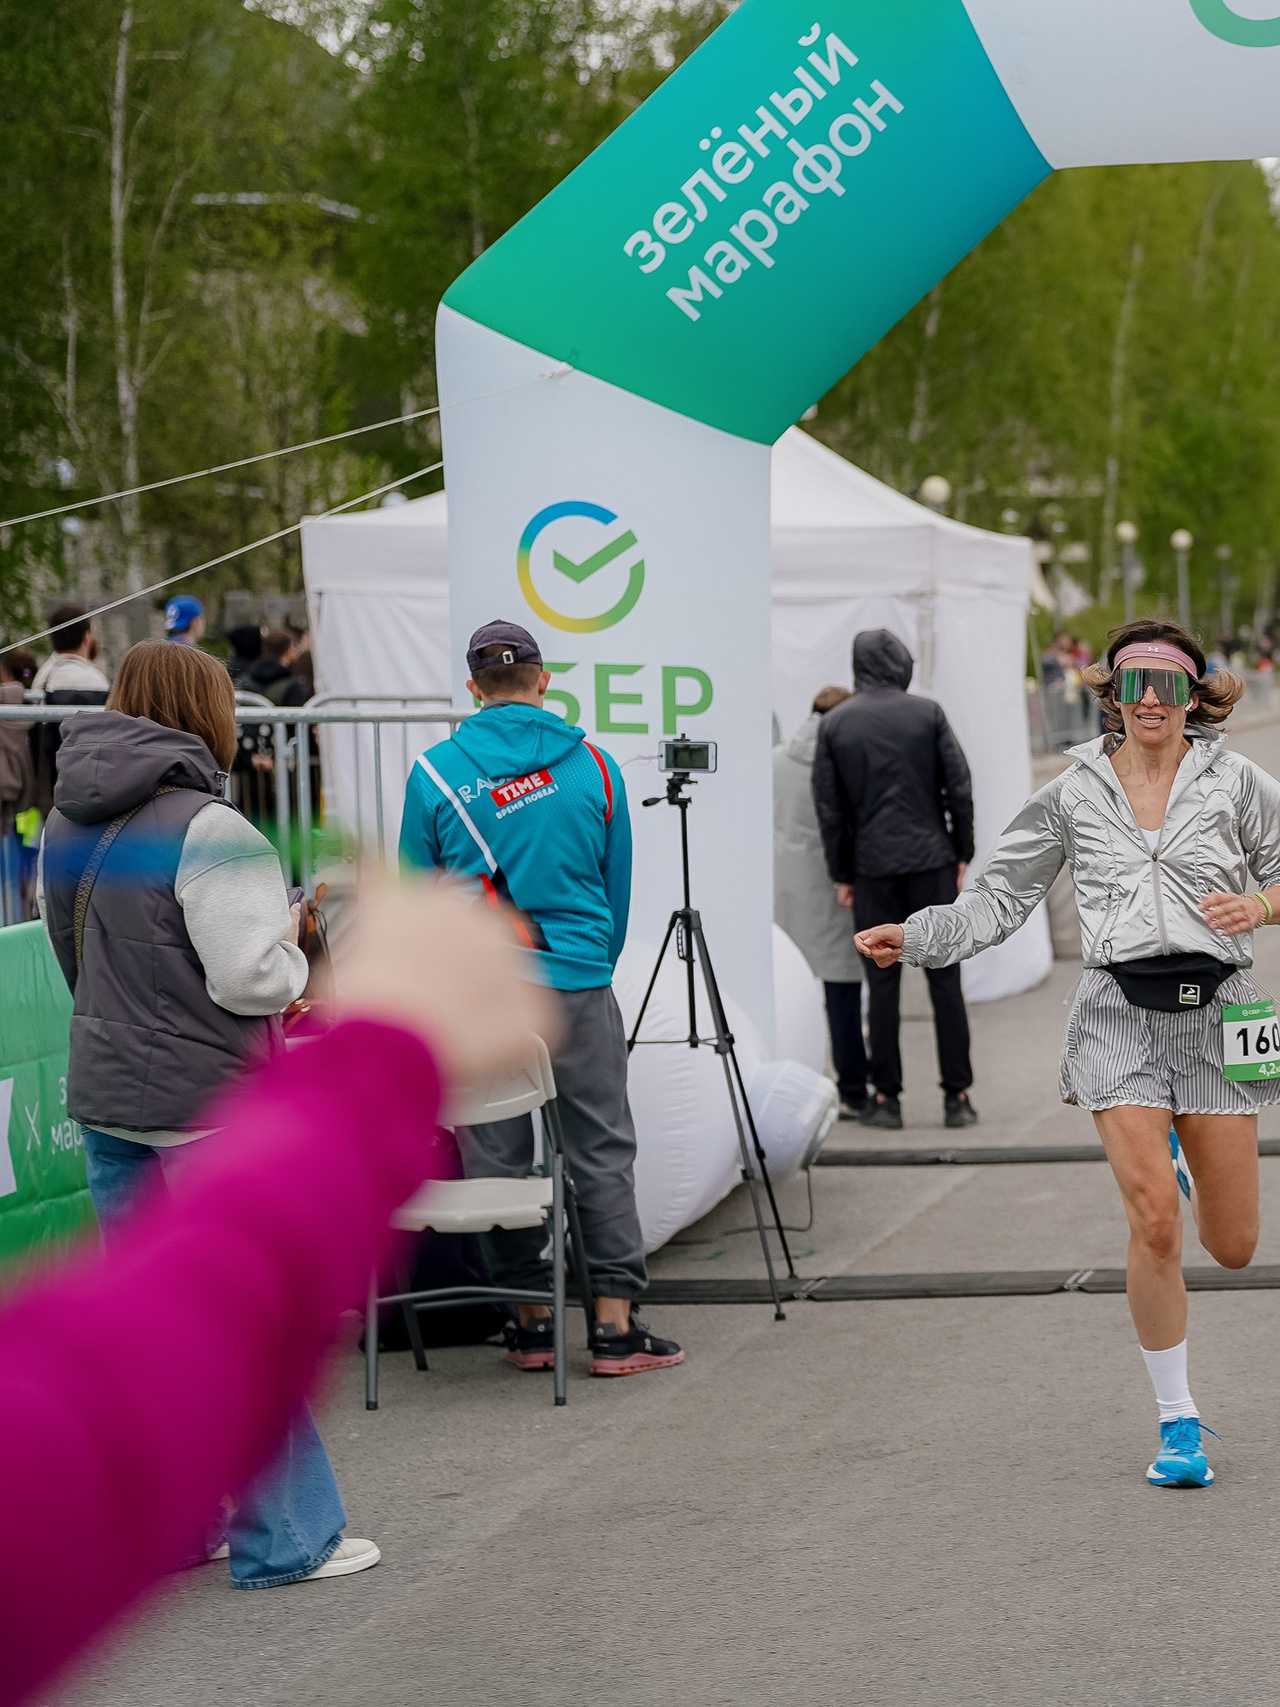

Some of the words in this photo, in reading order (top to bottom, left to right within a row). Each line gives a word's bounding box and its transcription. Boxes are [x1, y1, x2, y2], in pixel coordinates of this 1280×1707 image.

[623, 22, 859, 274] зелёный
[666, 79, 904, 321] марафон
[474, 662, 713, 735] БЕР
[495, 800, 525, 820] ВРЕМЯ
[498, 772, 544, 802] TIME
[1236, 1022, 1280, 1056] 160
